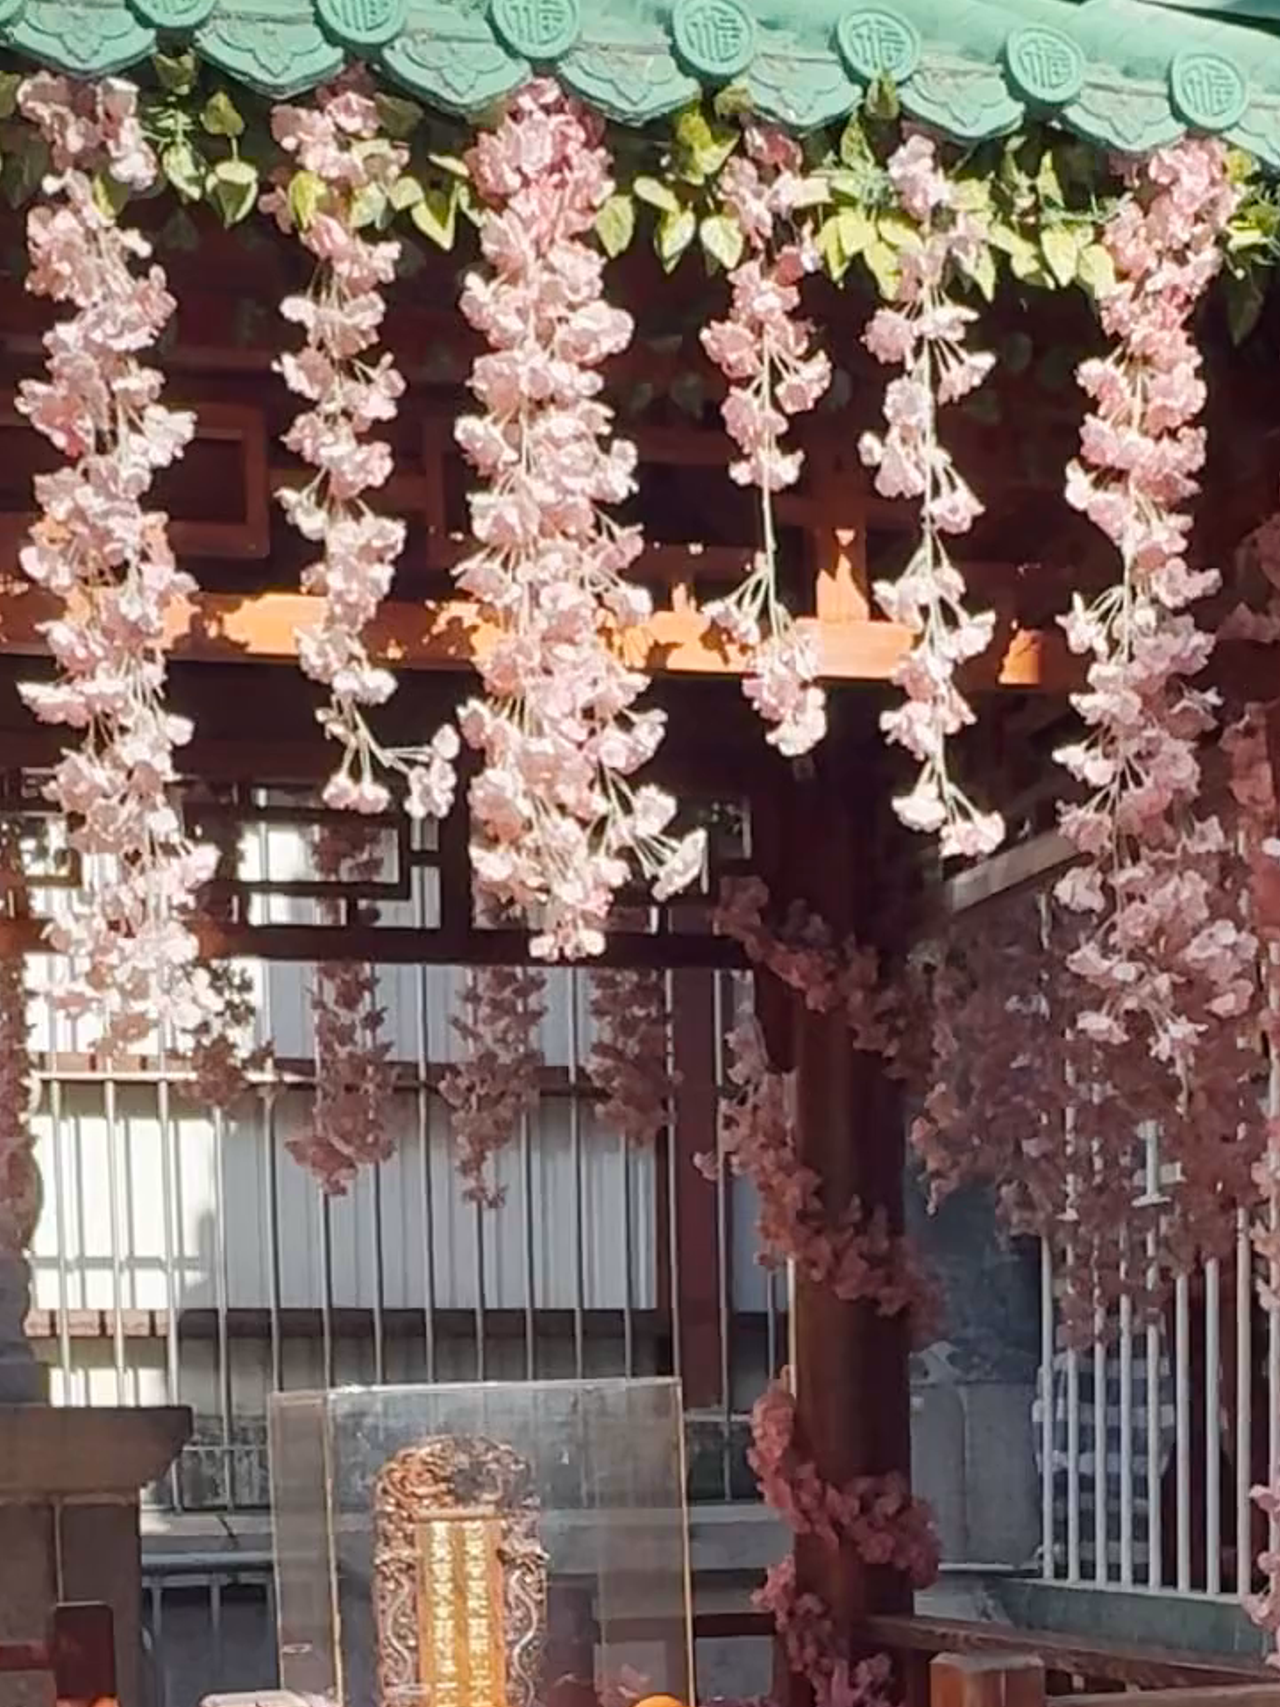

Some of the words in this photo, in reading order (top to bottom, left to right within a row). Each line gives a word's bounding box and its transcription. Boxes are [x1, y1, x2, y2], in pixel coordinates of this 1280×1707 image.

[688, 6, 742, 62] 福
[851, 17, 904, 69] 福
[1020, 36, 1072, 89] 福
[1181, 67, 1235, 117] 福
